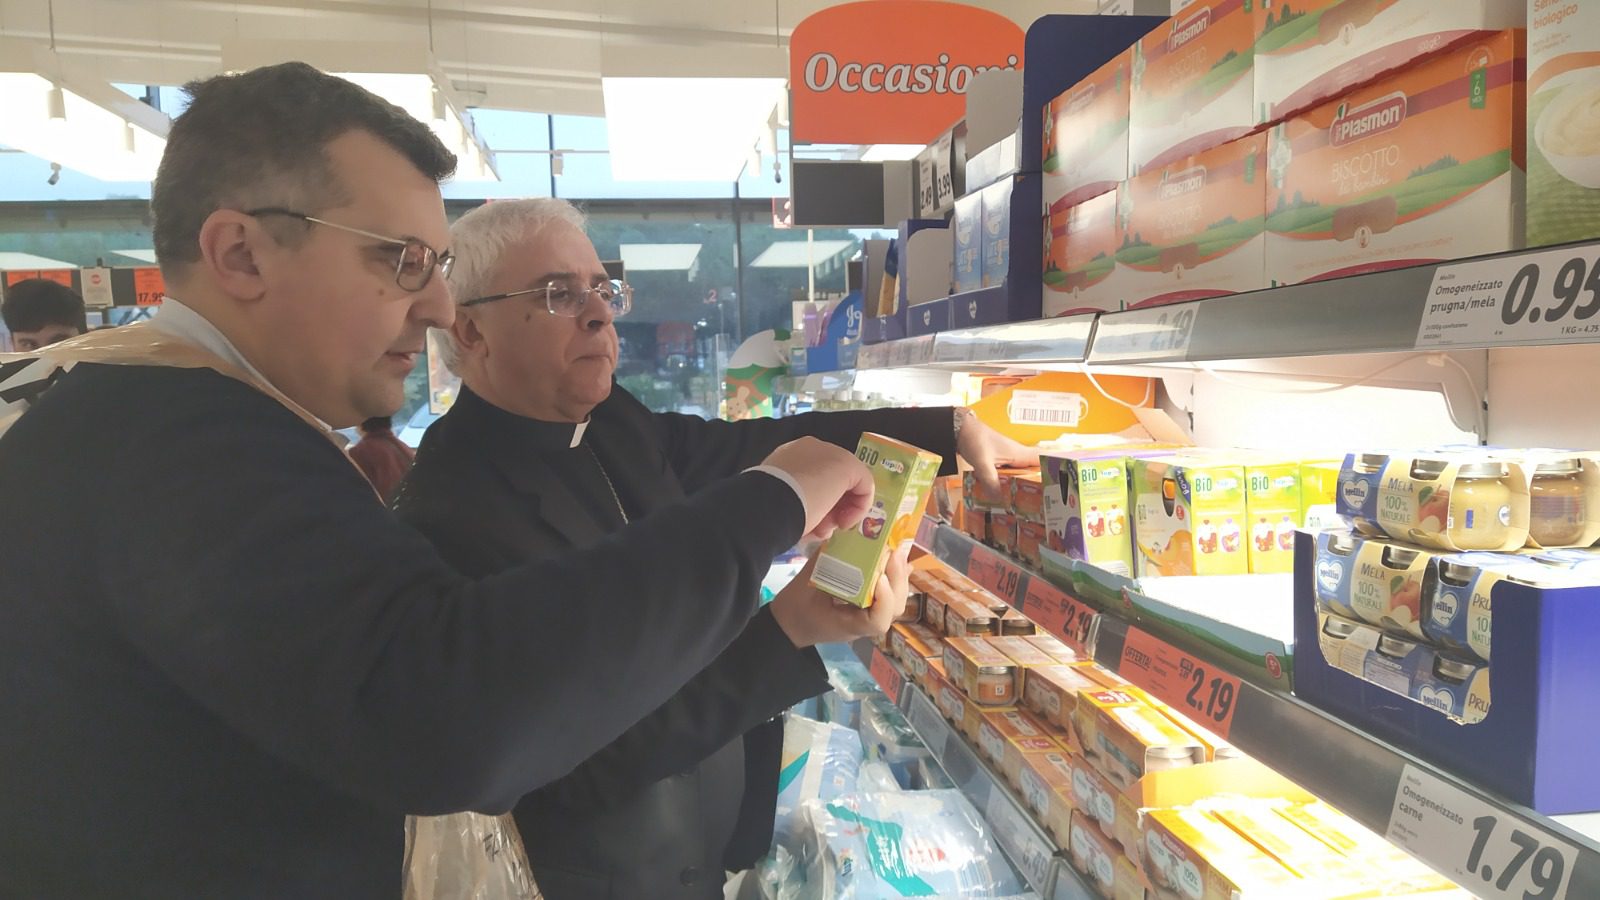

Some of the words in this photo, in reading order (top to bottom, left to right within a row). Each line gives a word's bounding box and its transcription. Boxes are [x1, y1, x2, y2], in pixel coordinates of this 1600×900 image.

[1534, 4, 1578, 29] biologico
[805, 52, 1018, 94] Occasio
[1474, 80, 1480, 96] 6
[1341, 105, 1400, 140] Plasmon
[1331, 145, 1400, 182] BISCOTTO
[1435, 280, 1503, 296] Omogeneizzato
[1501, 257, 1600, 325] 0.95
[1430, 296, 1496, 315] prugna/mela
[1565, 326, 1577, 334] KG
[860, 445, 879, 466] BiO
[1081, 468, 1097, 482] BiO
[1251, 476, 1269, 491] BiO
[1195, 478, 1212, 492] BiO
[1345, 487, 1365, 497] Mellin
[1388, 477, 1413, 494] MELA
[1381, 508, 1411, 523] NATURALE
[1361, 562, 1385, 580] MELA
[1473, 592, 1491, 611] PRU
[1476, 616, 1491, 633] 10
[1472, 630, 1490, 646] NATU
[1186, 667, 1234, 722] 2.19
[1423, 695, 1448, 711] Mellin
[1468, 693, 1489, 713] PRU
[1399, 802, 1424, 822] carne
[1403, 785, 1464, 825] Omogeneizzato
[1466, 815, 1565, 900] 1.79
